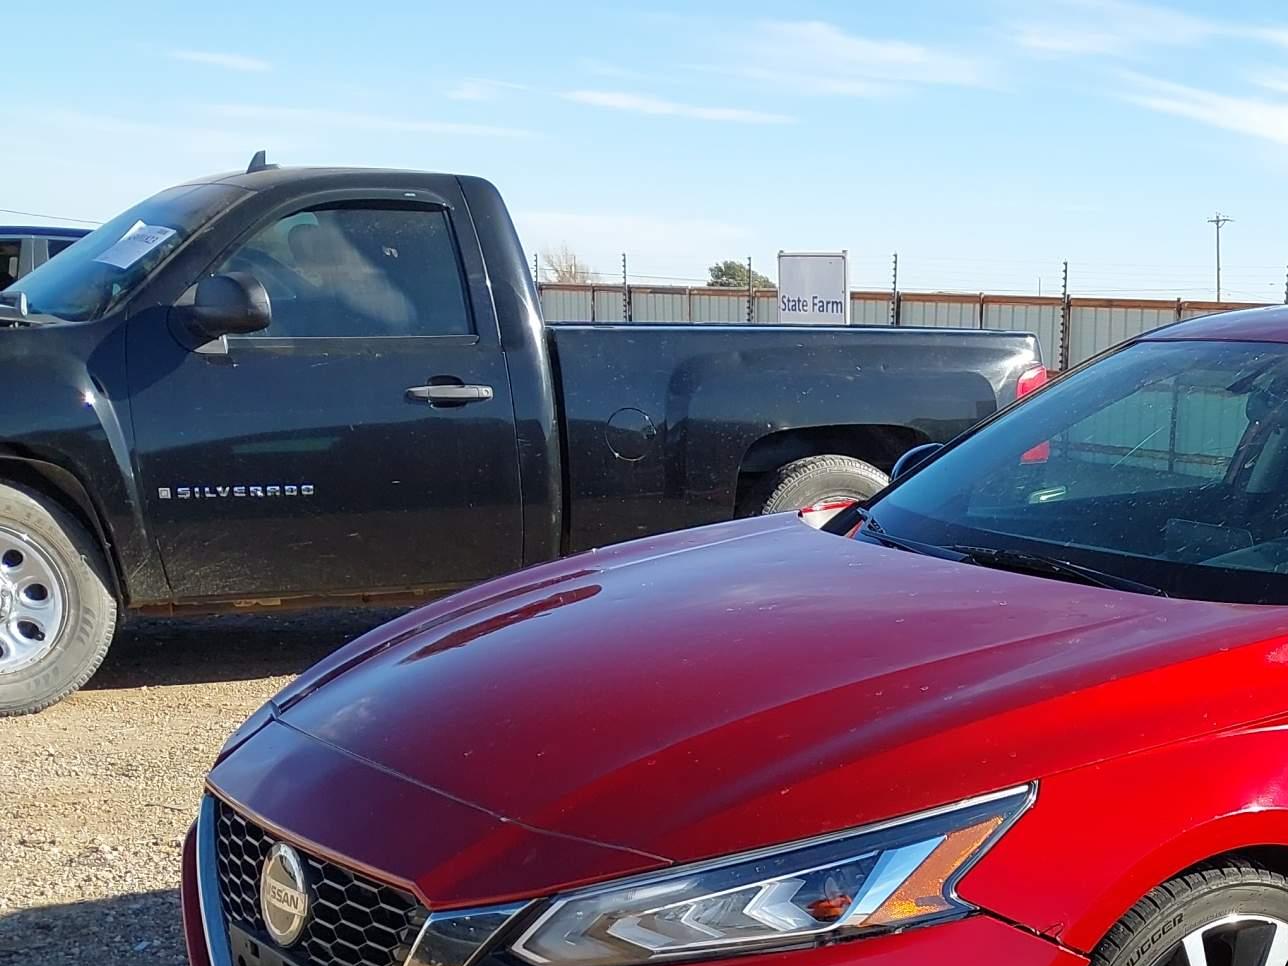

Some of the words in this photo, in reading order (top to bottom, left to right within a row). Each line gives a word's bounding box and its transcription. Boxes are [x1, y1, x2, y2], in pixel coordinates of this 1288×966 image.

[781, 295, 808, 313] State
[812, 296, 843, 314] Farm
[177, 485, 314, 499] SILVERADO
